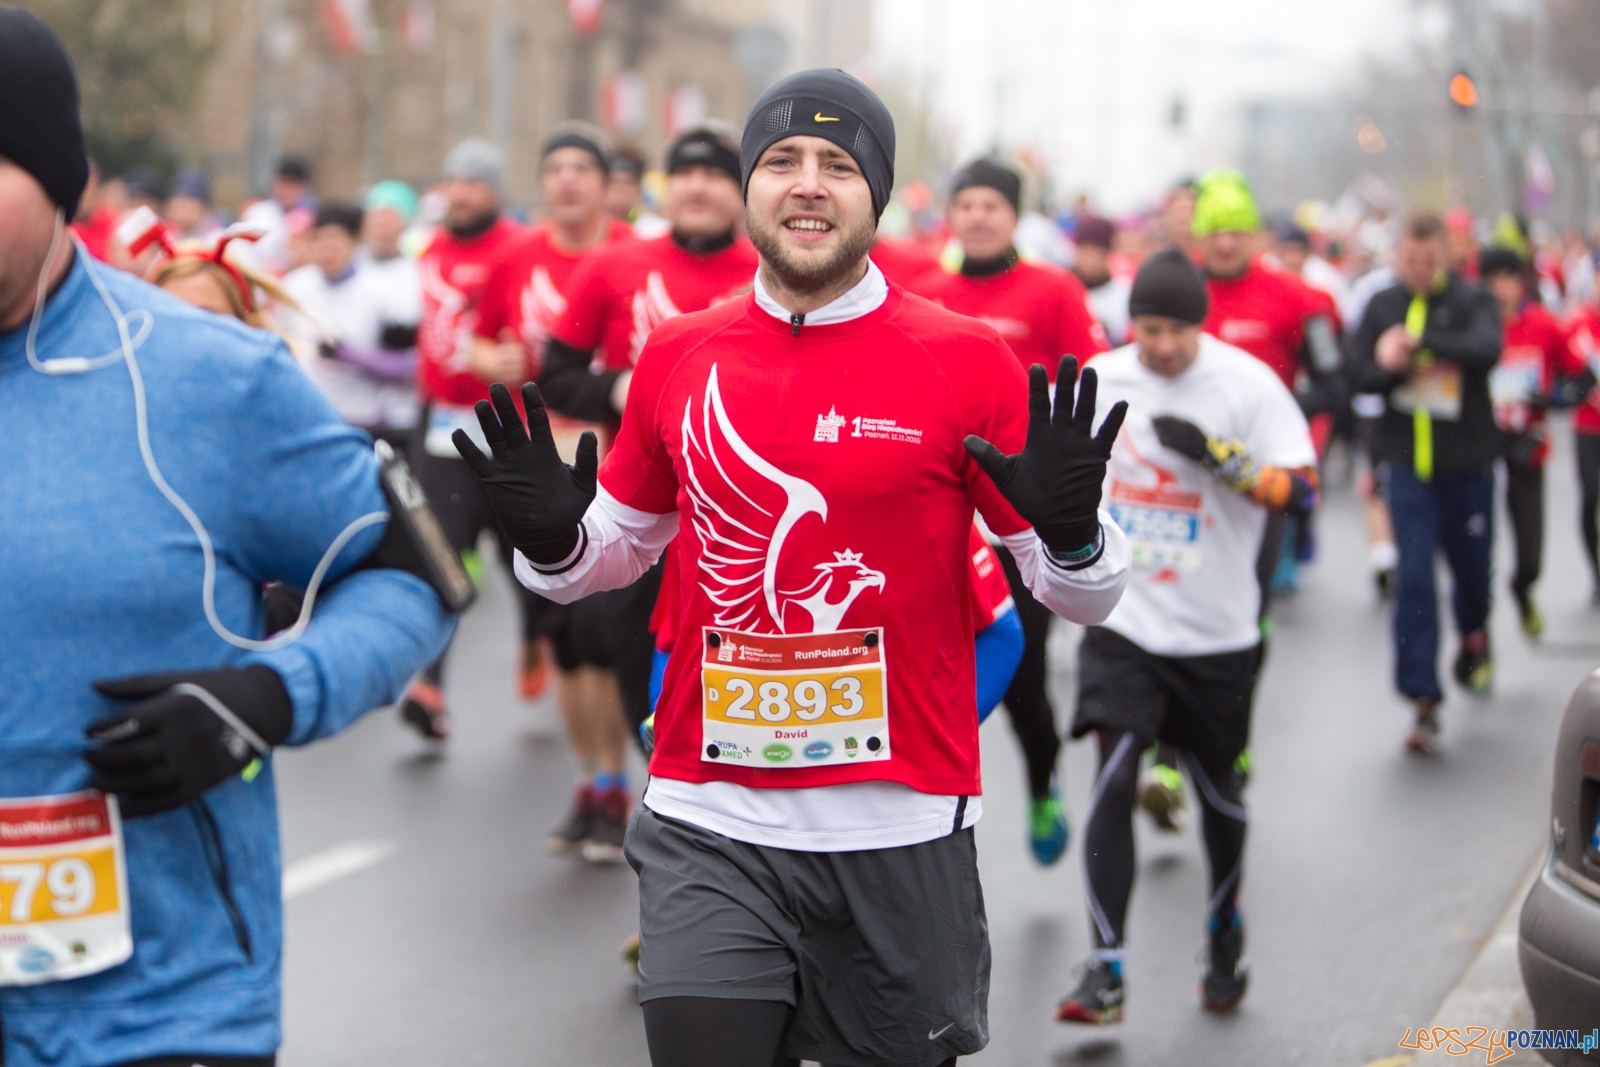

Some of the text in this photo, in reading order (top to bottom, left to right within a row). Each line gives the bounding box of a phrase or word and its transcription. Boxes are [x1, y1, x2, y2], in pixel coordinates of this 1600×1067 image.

[851, 416, 862, 438] 1
[795, 646, 868, 660] RunPoland.org
[708, 676, 865, 722] D 2893
[774, 730, 808, 739] David
[0, 857, 97, 922] 79
